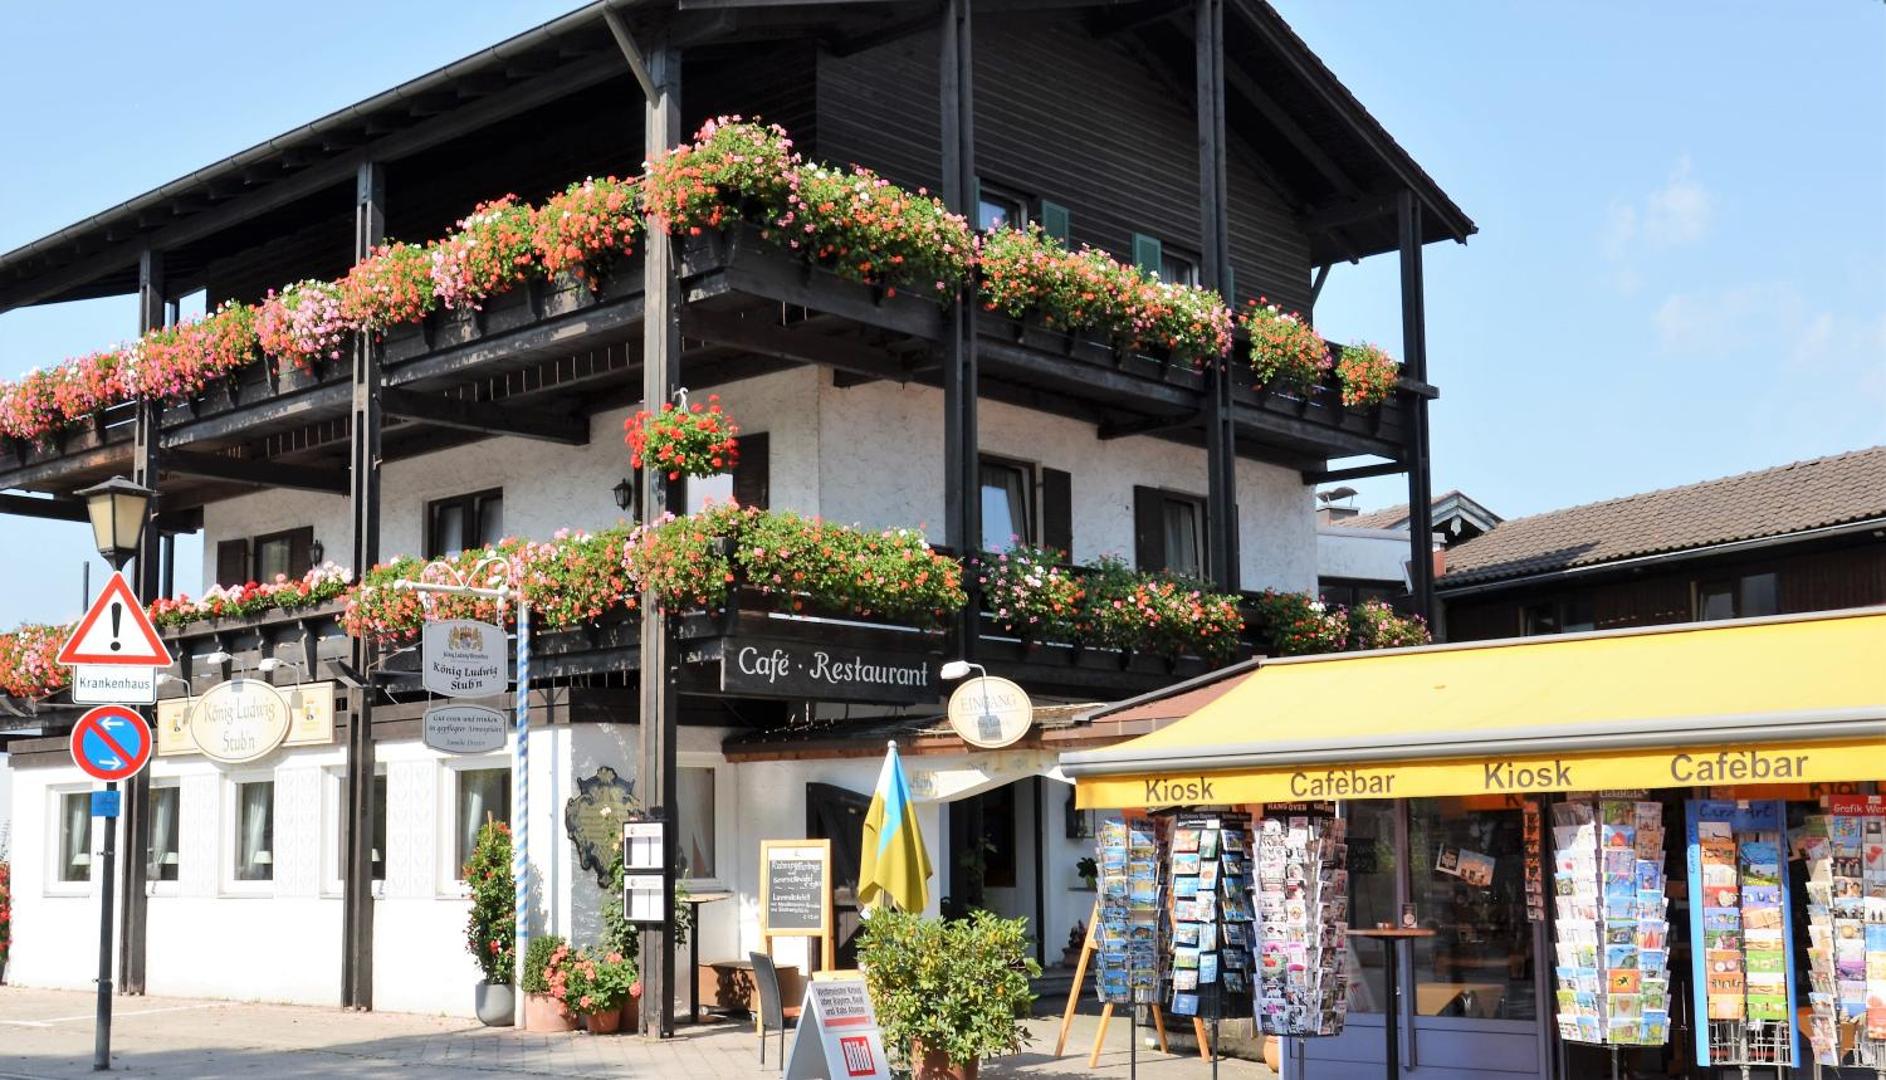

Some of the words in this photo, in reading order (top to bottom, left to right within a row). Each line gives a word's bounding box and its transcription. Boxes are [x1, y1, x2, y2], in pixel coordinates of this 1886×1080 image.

[433, 662, 461, 680] König
[464, 665, 498, 679] Ludwig
[738, 646, 789, 683] Café
[809, 652, 928, 687] Restaurant
[79, 677, 151, 690] Krankenhaus
[203, 701, 234, 726] König
[236, 697, 276, 722] Ludwig
[1145, 776, 1214, 803] Kiosk
[1290, 770, 1396, 797] Cafèbar
[1484, 759, 1572, 790] Kiosk
[1670, 750, 1809, 783] Cafèbar
[1833, 803, 1863, 813] Grafik
